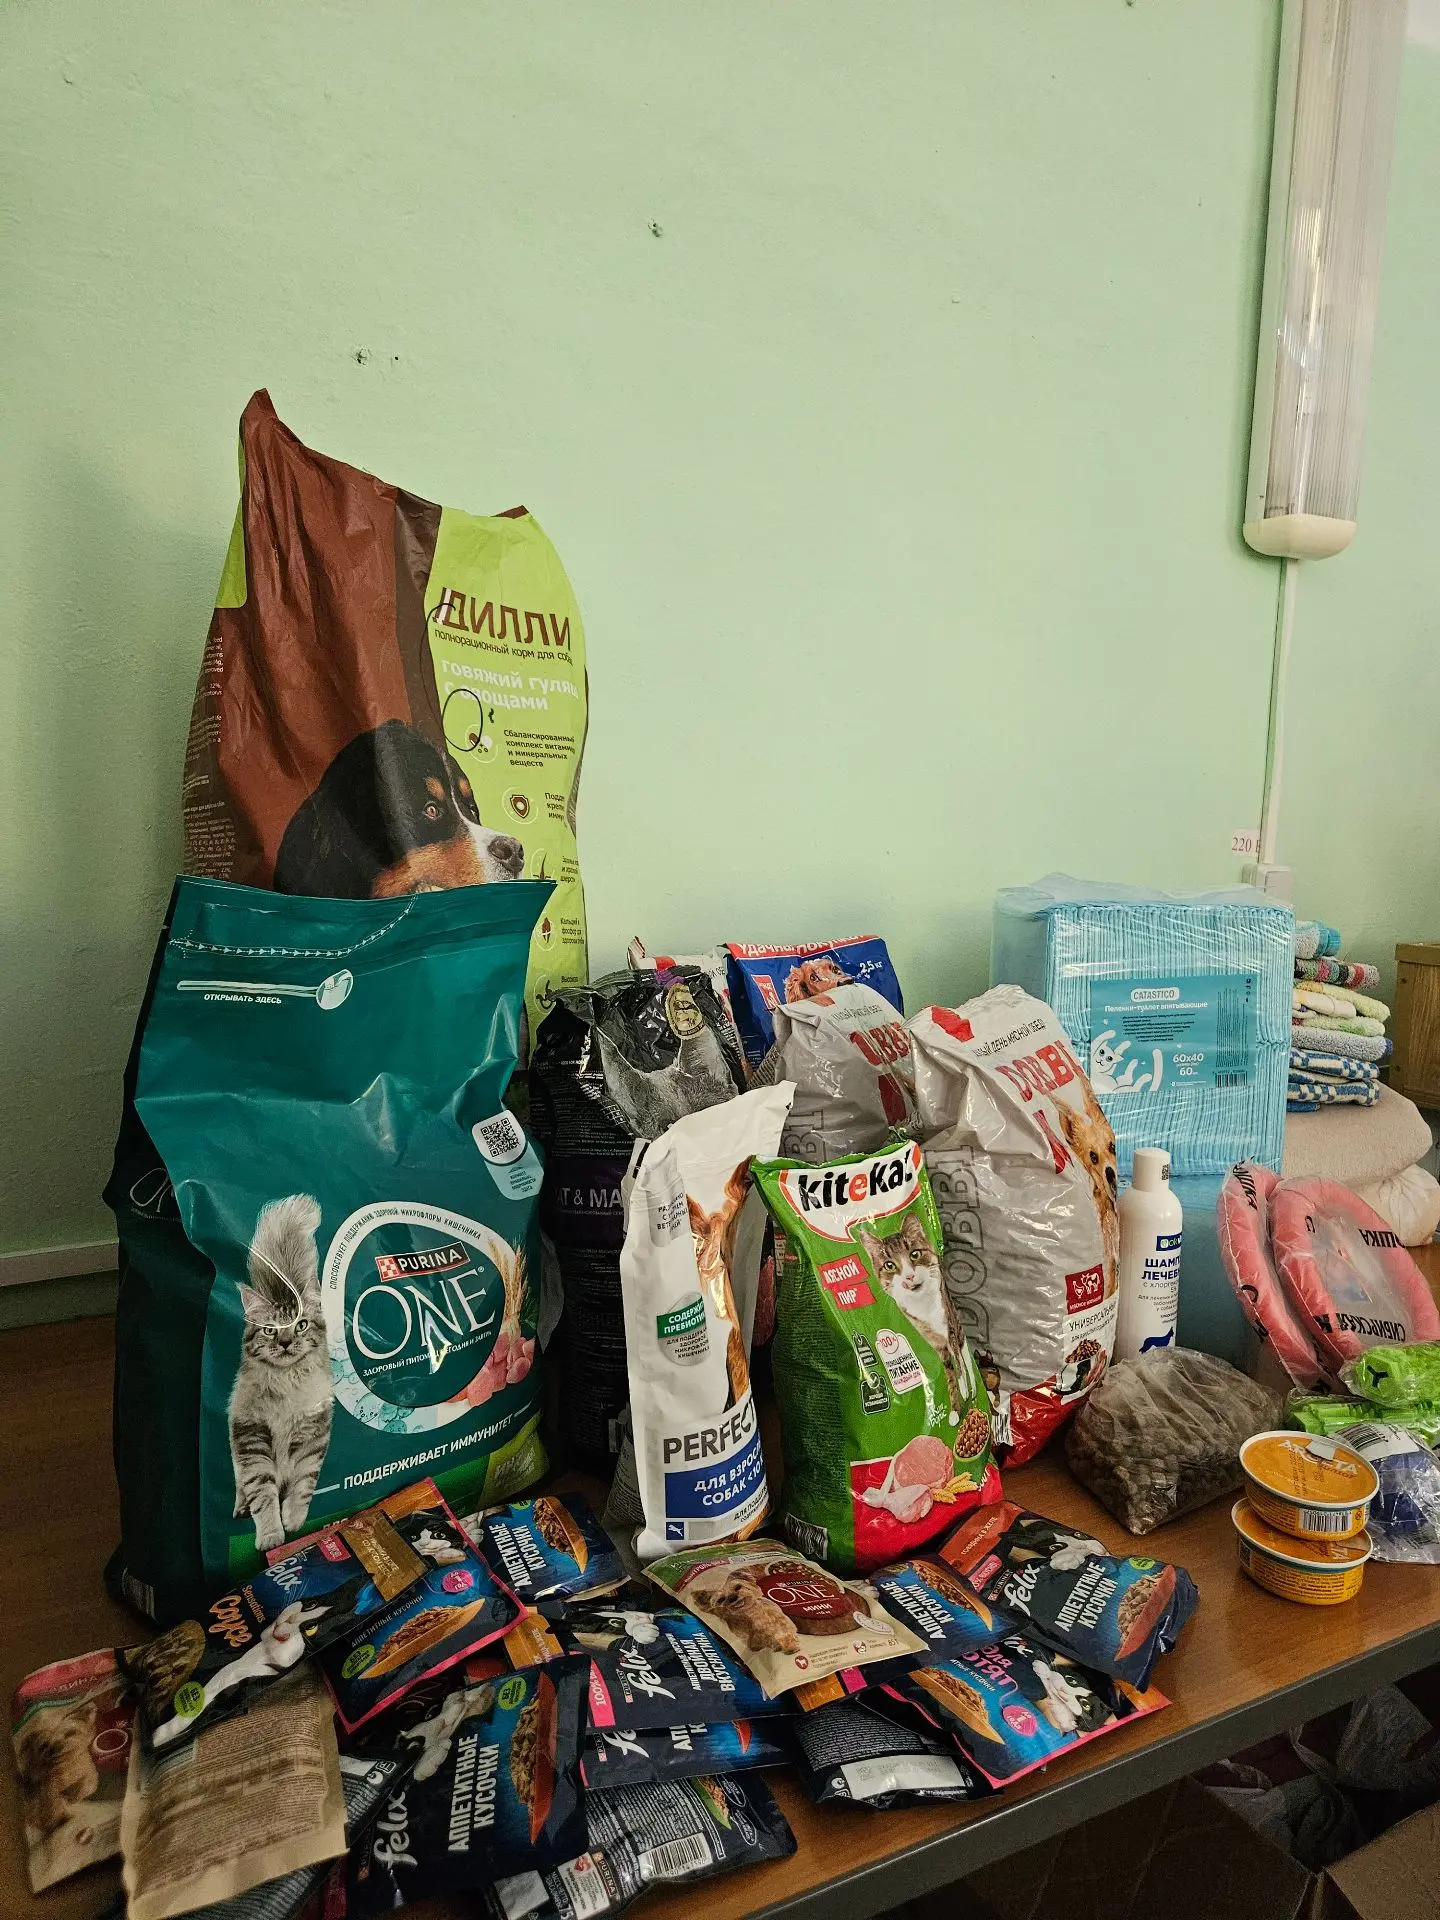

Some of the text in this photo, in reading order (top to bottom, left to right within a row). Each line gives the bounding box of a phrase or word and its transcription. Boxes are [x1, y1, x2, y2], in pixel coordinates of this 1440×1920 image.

[434, 629, 509, 655] полнорационный
[512, 647, 534, 660] корм
[537, 650, 554, 660] для
[441, 659, 523, 690] говяжий
[506, 740, 543, 749] комплекс
[515, 751, 568, 760] минеральных
[1231, 837, 1251, 852] 220
[859, 961, 875, 975] 2,5
[204, 993, 282, 1004] ОТКРЫВАТЬ ЗДЕСЬ
[1133, 989, 1175, 1000] CATASTICO
[1179, 1067, 1193, 1076] 60
[330, 1242, 347, 1290] СПОСОБСТВУЕТ
[400, 1208, 442, 1224] МИКРОФЛОРЫ
[444, 1217, 482, 1241] КИШЕЧНИКА
[397, 1248, 463, 1272] PURINA
[352, 1267, 496, 1360] ONE
[362, 1360, 405, 1377] ЗДОРОВЫЙ
[343, 1413, 513, 1489] ПОДДЕРЖИВАЕТ ИММУНИТЕТ
[694, 1473, 727, 1492] ДЛЯ
[702, 1477, 747, 1506] СОБАК
[488, 1523, 547, 1587] АППЕТИТНЫЕ КУСОЧКИ
[767, 1584, 835, 1604] ONE
[802, 1603, 833, 1612] МИНИ
[904, 1583, 955, 1624] КУСОЧКИ
[1053, 1560, 1106, 1633] АППЕТИТНЫЕ
[1076, 1576, 1119, 1630] КУСОЧКИ
[351, 1595, 424, 1649] АППЕТИТНЫЕ КУСОЧКИ
[880, 1580, 947, 1641] АППЕТИТНЫЕ
[680, 1639, 717, 1682] ДВОЙНАЯ
[692, 1631, 736, 1692] ВКУСНЯТИНА
[447, 1733, 479, 1851] АППЕТИТНЫЕ
[473, 1743, 500, 1830] КУСОЧКИ
[373, 1791, 418, 1871] felix
[600, 1860, 616, 1898] PURINA
